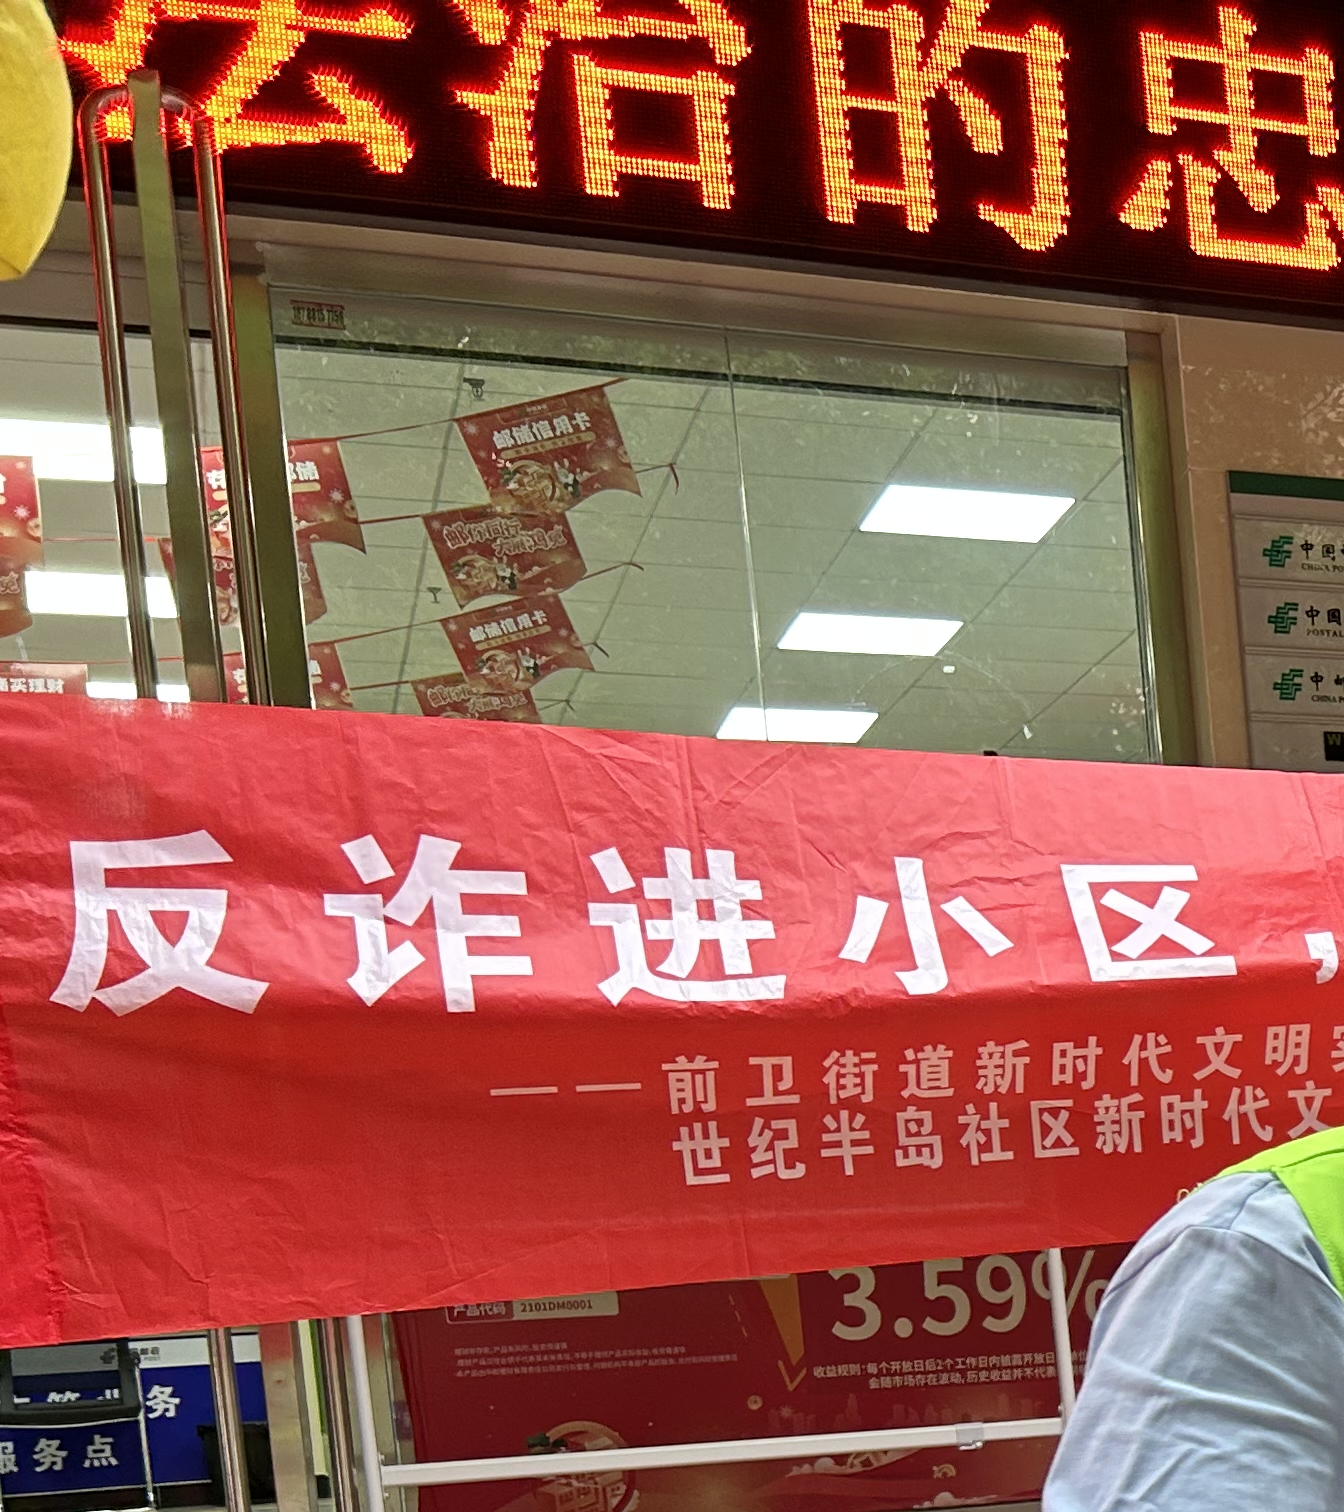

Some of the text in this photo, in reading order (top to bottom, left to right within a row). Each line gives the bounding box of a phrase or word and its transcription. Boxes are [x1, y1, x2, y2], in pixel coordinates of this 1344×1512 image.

[492, 412, 591, 450] 邮储信用卡
[1301, 562, 1330, 571] CHINA
[1306, 628, 1344, 639] POSTAL
[1311, 693, 1337, 703] CHINA
[453, 1301, 506, 1317] 产品代码
